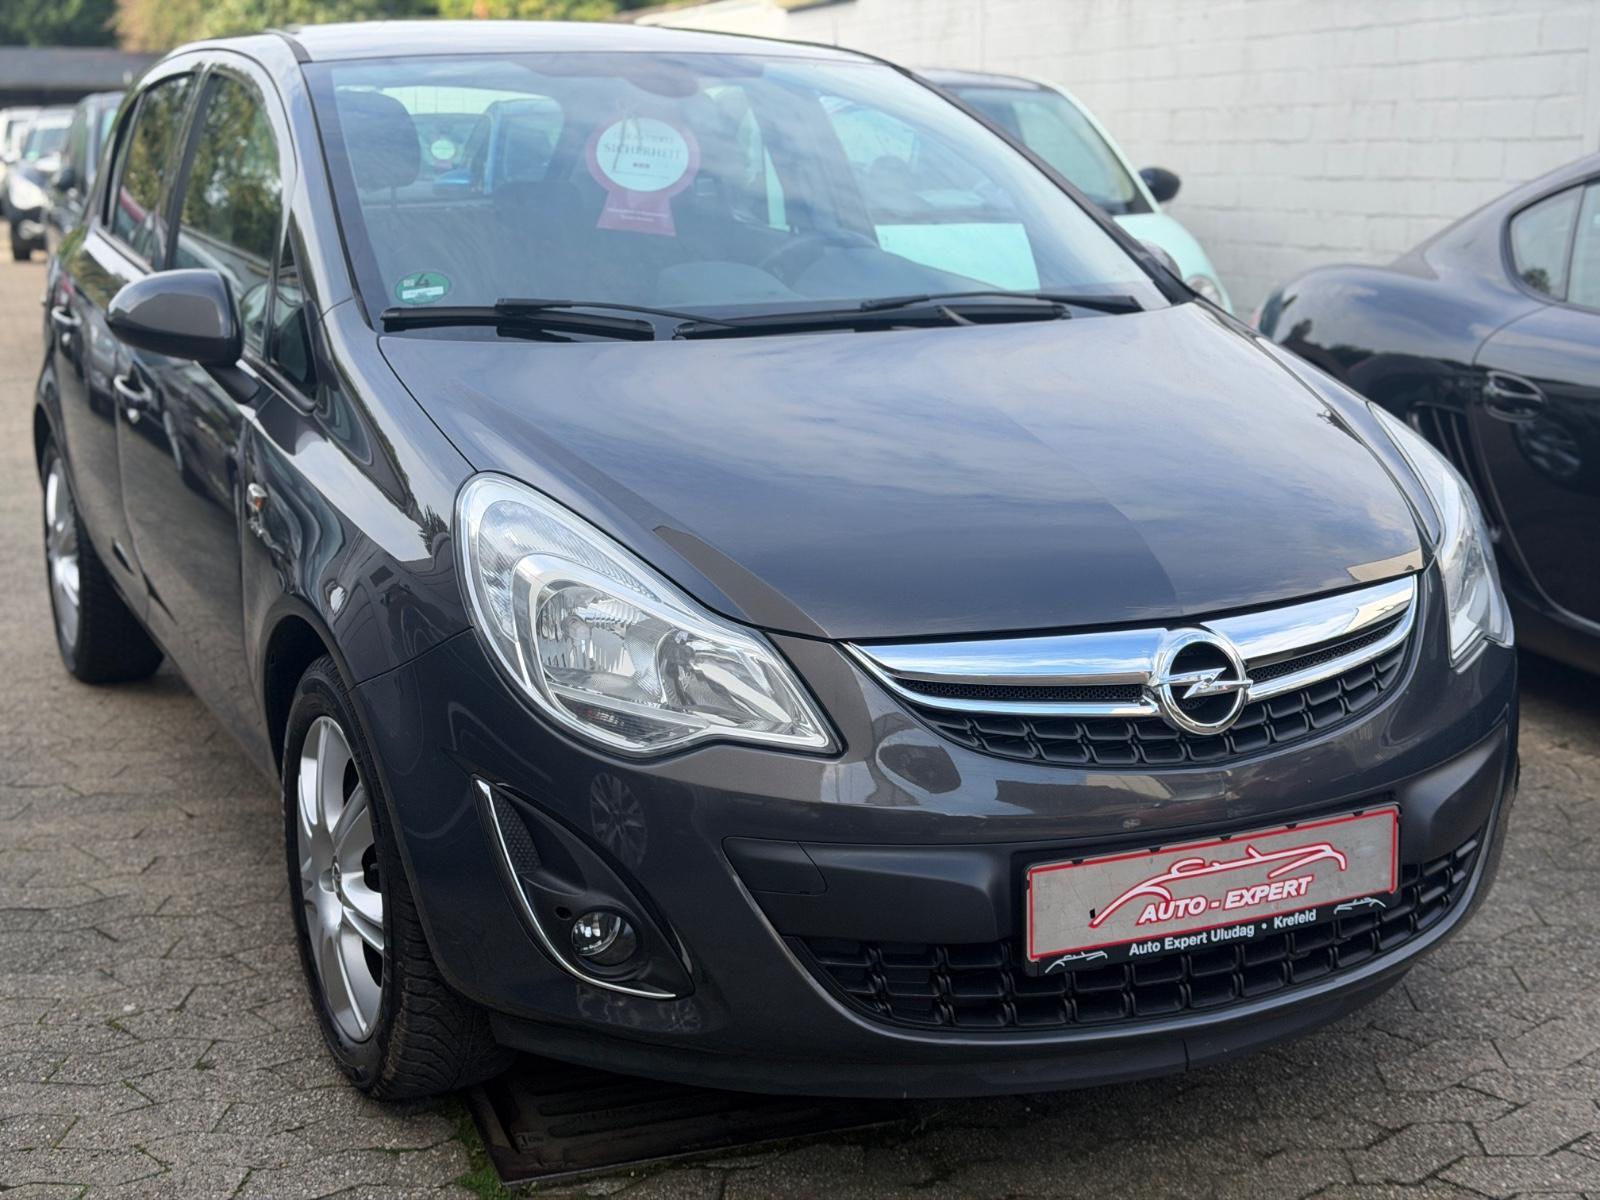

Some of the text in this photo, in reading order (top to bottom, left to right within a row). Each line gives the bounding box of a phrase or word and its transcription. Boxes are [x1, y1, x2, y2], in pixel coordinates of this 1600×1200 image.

[1128, 942, 1161, 956] Auto
[1164, 934, 1208, 950] Expert
[1210, 923, 1255, 942] Uludag
[1273, 908, 1317, 930] Krefeld
